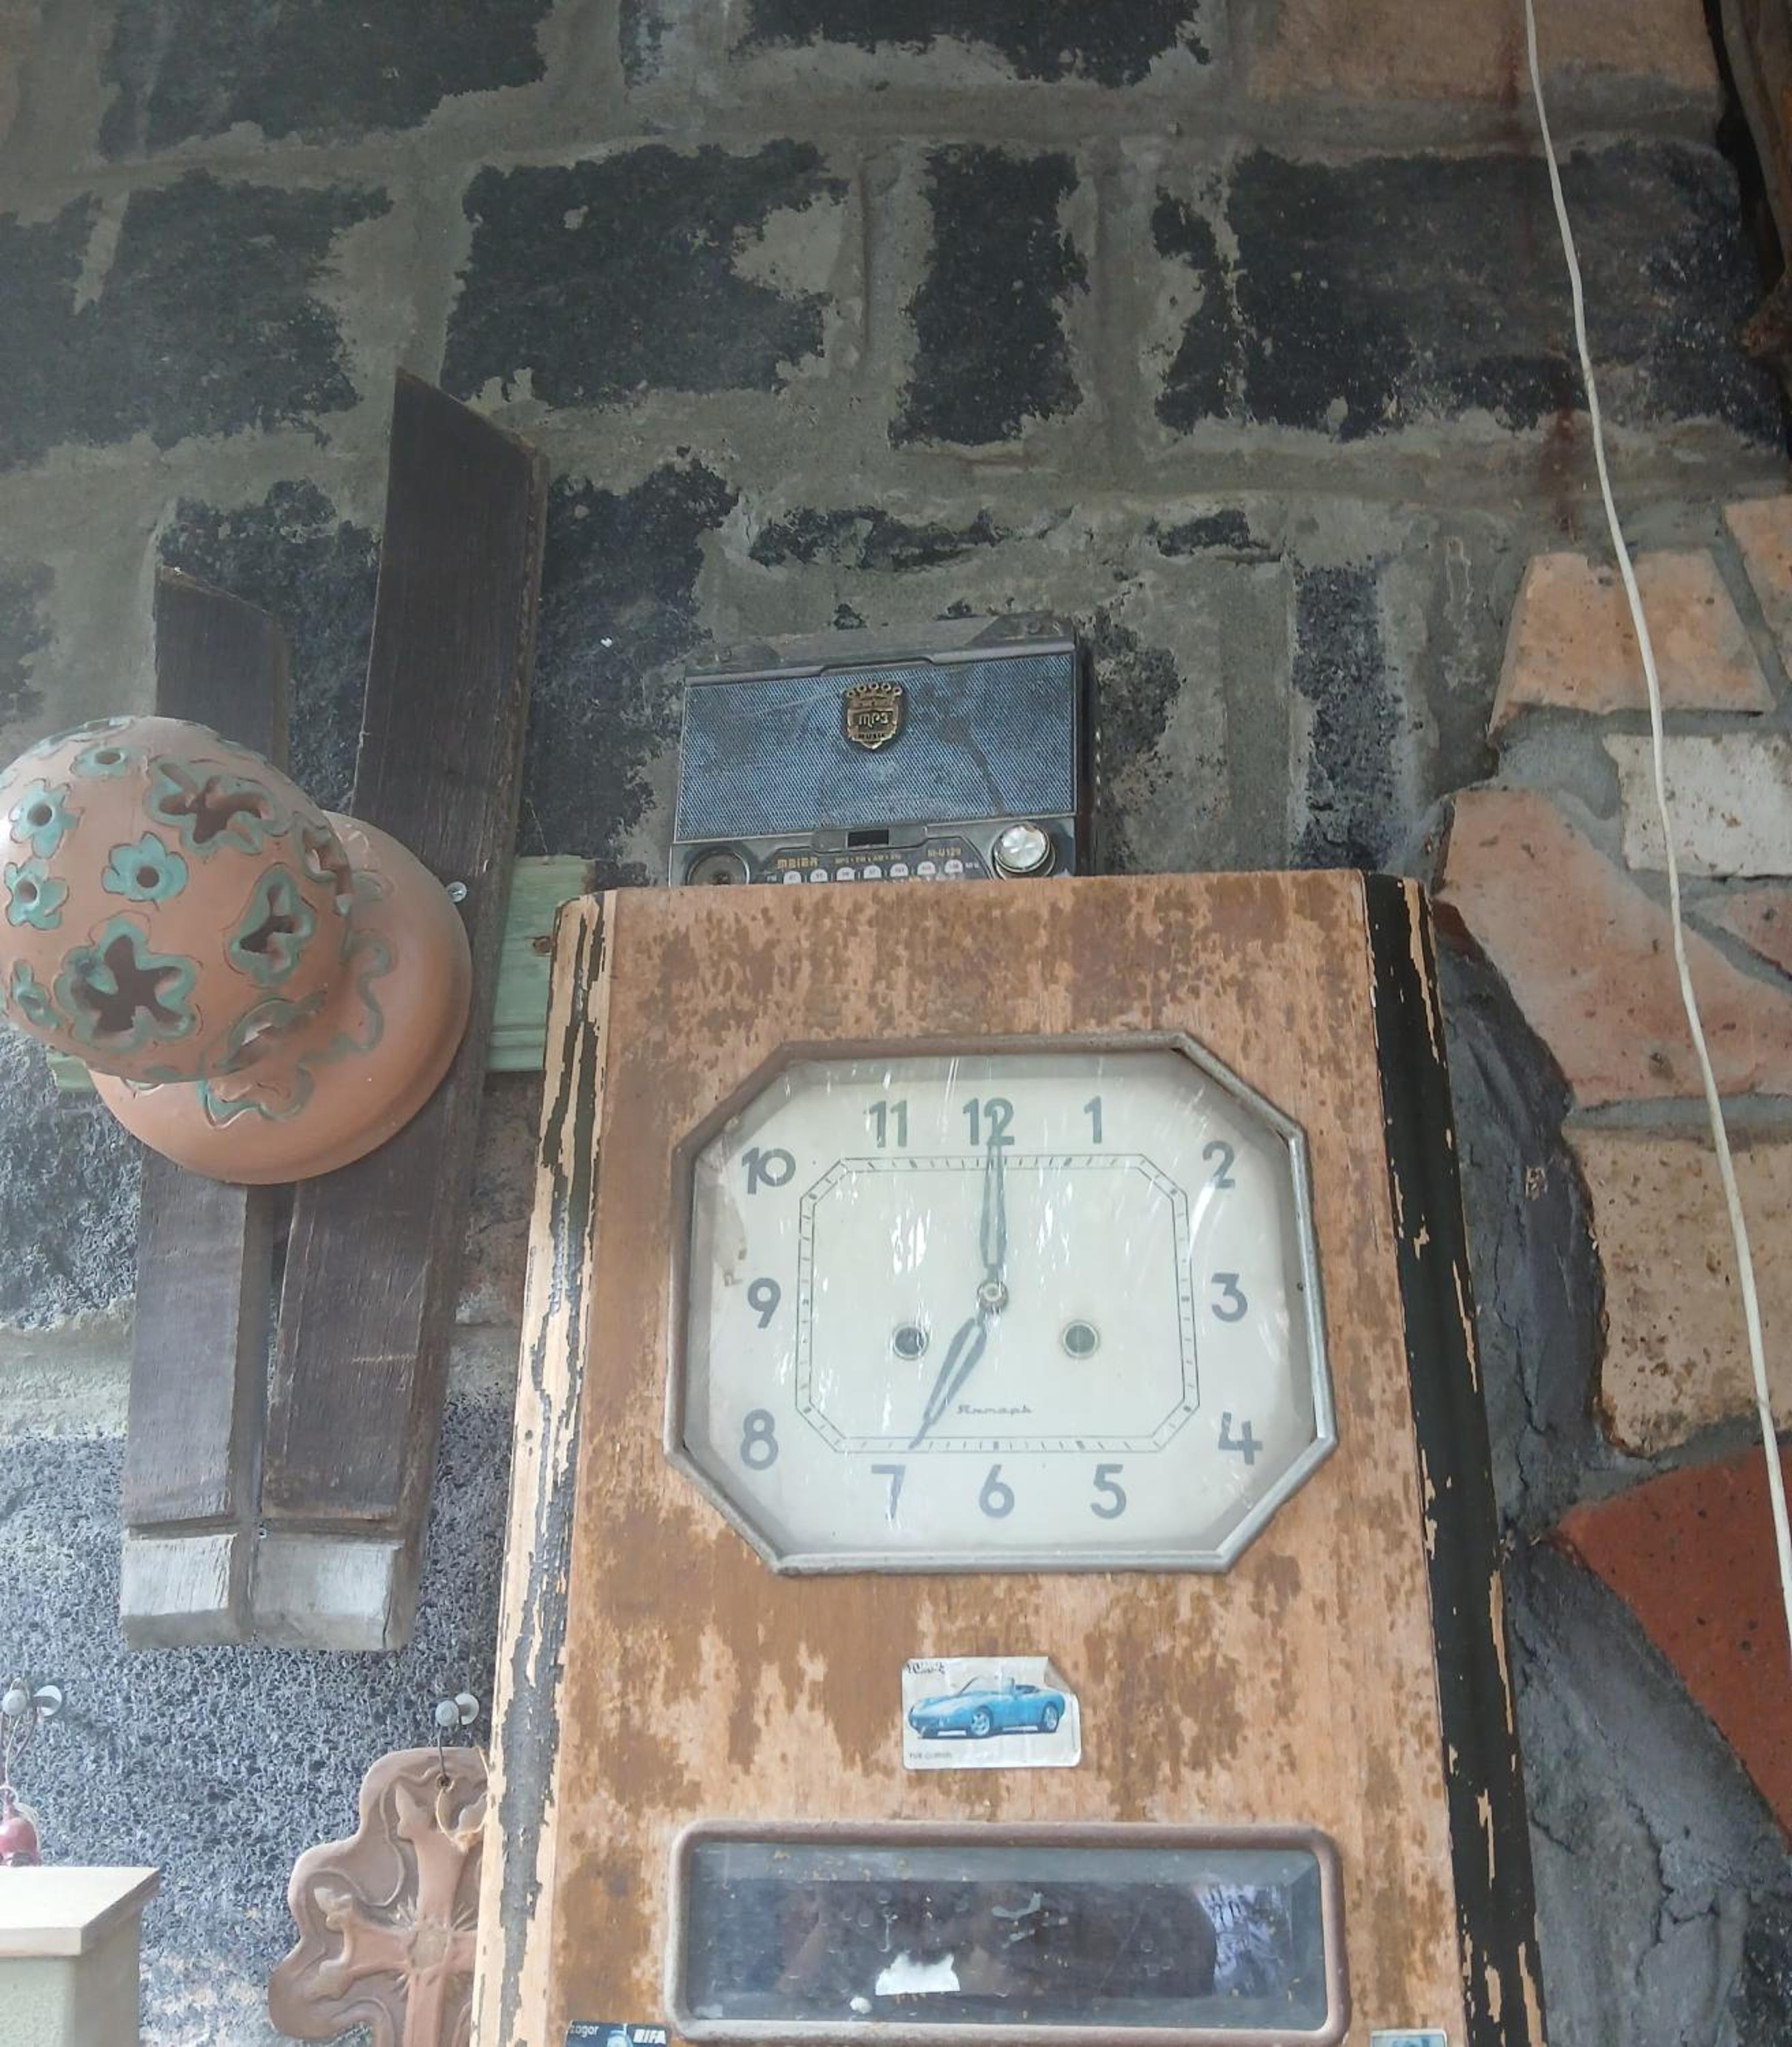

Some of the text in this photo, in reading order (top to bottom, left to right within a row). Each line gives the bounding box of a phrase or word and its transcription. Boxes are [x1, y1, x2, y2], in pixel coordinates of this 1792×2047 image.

[864, 1099, 908, 1148] 11
[962, 1097, 1015, 1146] 12
[1084, 1095, 1102, 1144] 1
[740, 1147, 796, 1194] 10
[1202, 1140, 1236, 1189] 2
[747, 1277, 781, 1329] 9
[1211, 1273, 1248, 1322] 3
[740, 1410, 779, 1470] 8
[1218, 1411, 1263, 1465] 4
[871, 1464, 906, 1520] 7
[979, 1464, 1015, 1518] 6
[1090, 1464, 1127, 1519] 5
